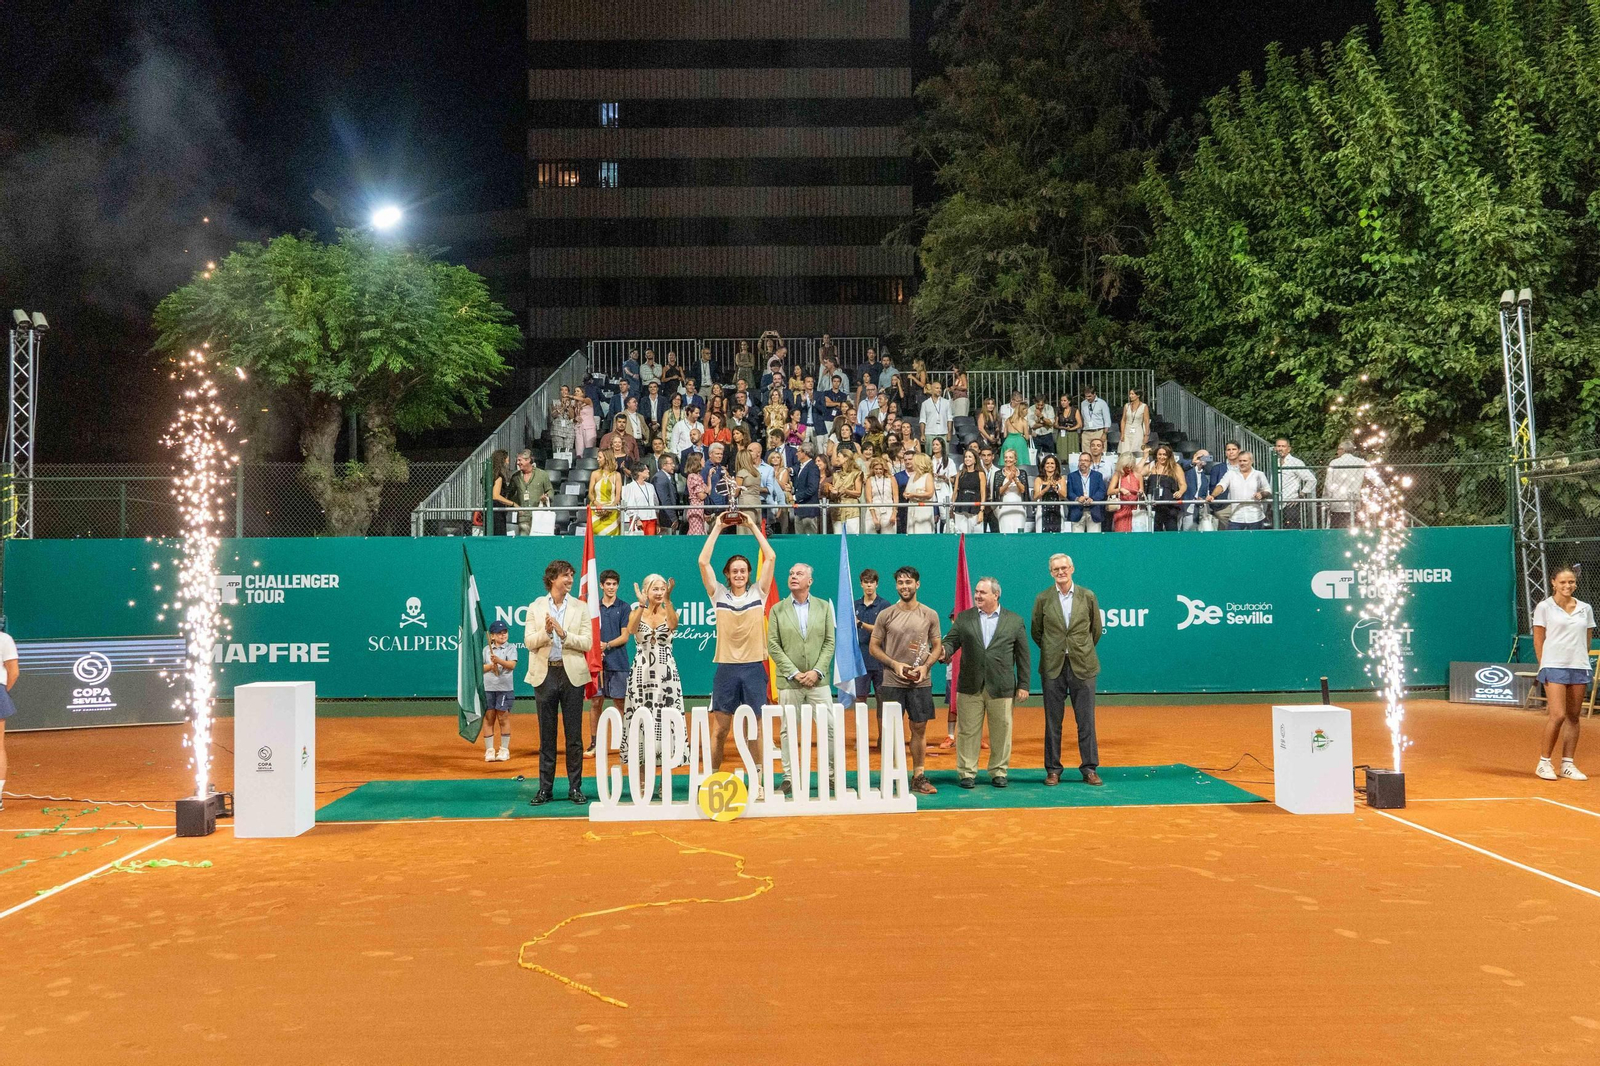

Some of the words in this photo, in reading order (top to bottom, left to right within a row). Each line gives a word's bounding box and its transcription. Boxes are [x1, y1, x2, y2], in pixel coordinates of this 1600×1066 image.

[245, 574, 339, 589] CHALLENGER
[245, 590, 285, 603] TOUR
[1226, 602, 1272, 612] Diputación
[1099, 608, 1149, 627] nsur
[1226, 611, 1273, 625] Sevilla
[368, 635, 458, 651] SCALPERS
[72, 688, 112, 697] COPA
[595, 706, 713, 807] COPA
[733, 701, 909, 804] SEVILLA
[708, 780, 739, 813] 62
